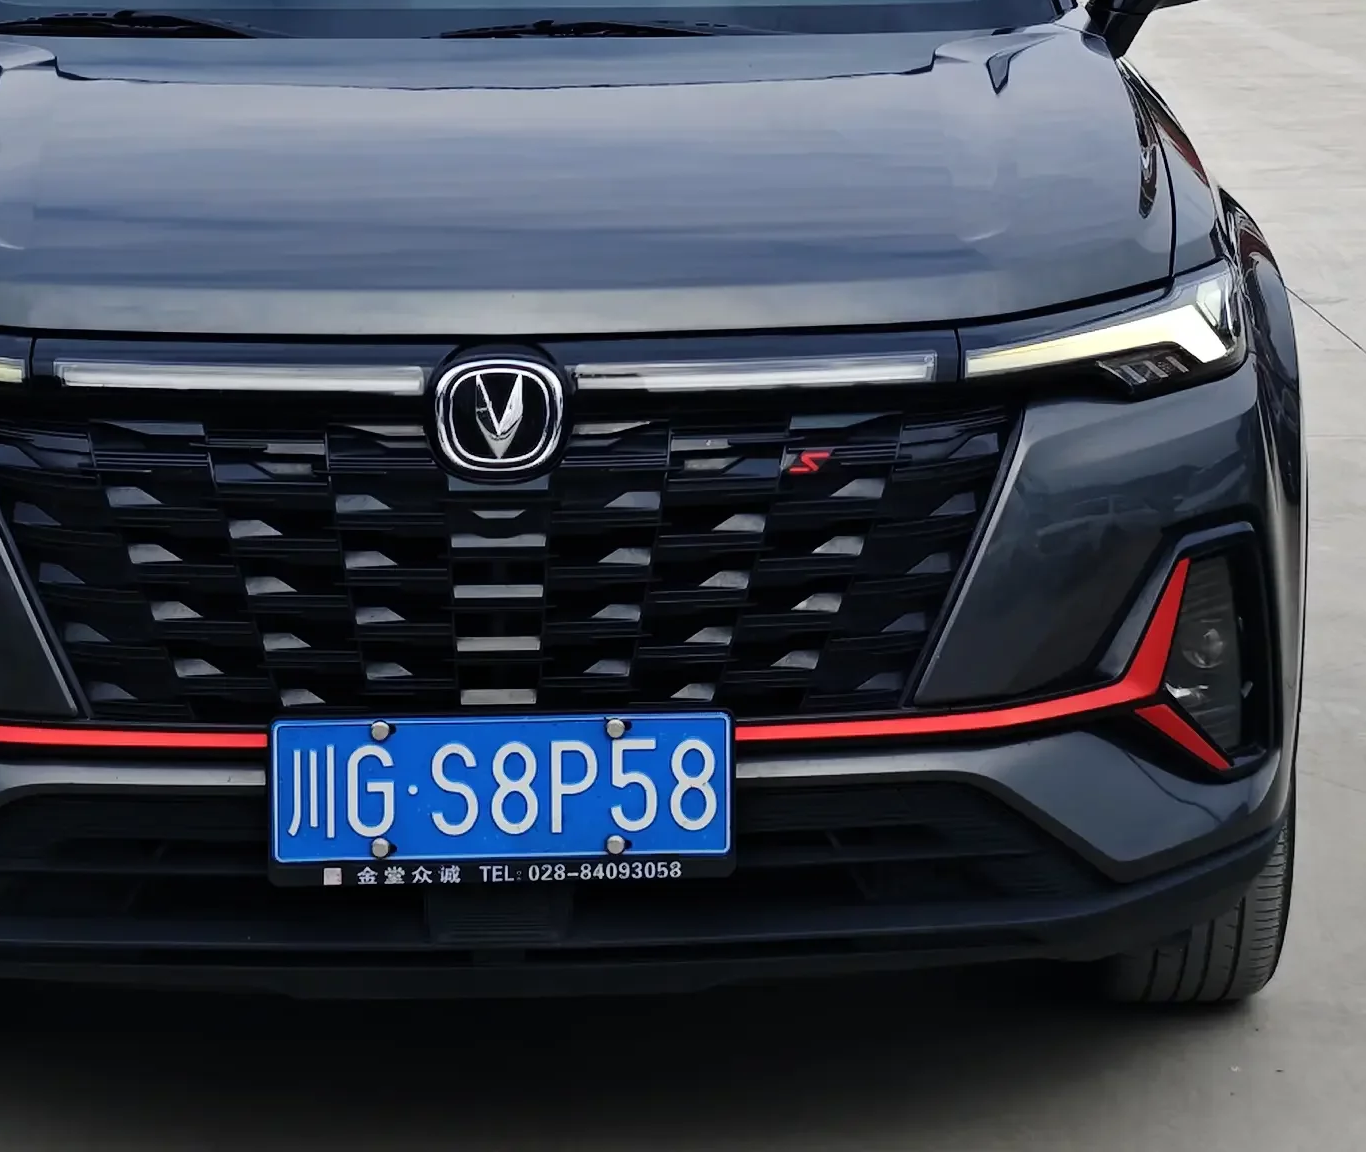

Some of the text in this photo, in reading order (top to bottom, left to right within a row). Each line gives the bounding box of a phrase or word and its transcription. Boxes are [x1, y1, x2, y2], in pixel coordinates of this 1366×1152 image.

[287, 737, 718, 839] 川G·S8P58
[357, 864, 462, 885] 金堂众诚
[528, 861, 682, 881] 028-84093058
